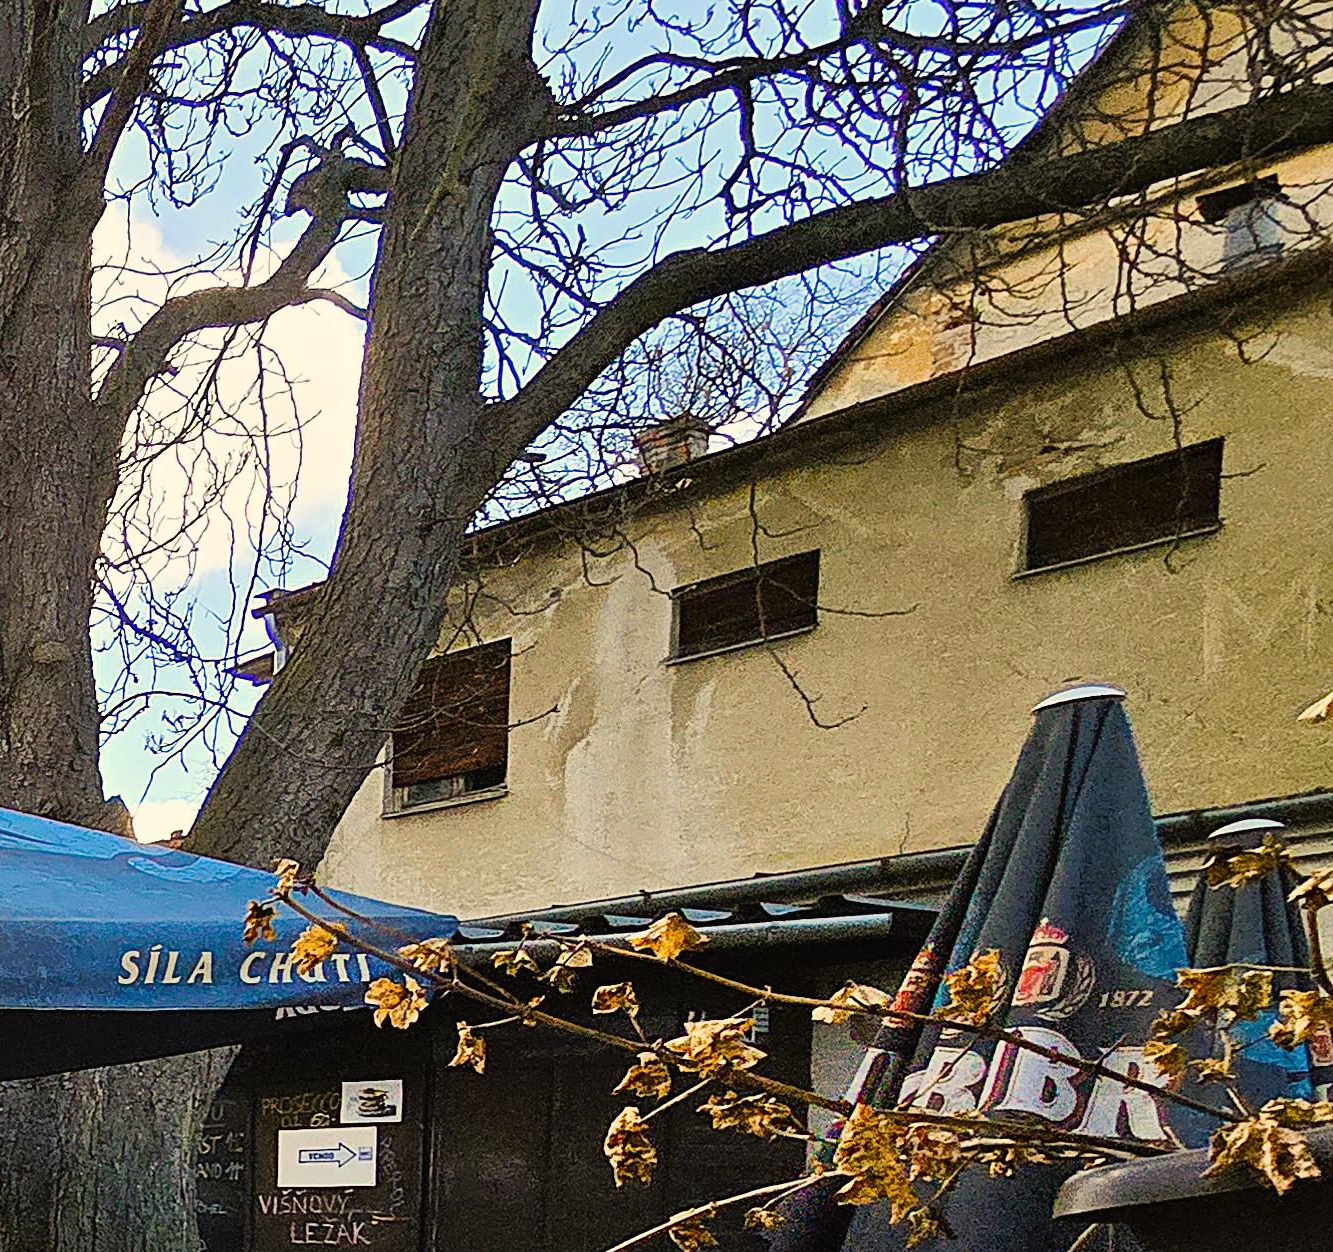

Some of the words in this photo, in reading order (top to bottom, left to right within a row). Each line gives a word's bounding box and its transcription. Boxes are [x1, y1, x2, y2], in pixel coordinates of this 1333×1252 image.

[118, 944, 213, 985] SÍLA
[1097, 989, 1153, 1008] 1872
[258, 1189, 353, 1215] VIŠŇOVÝ
